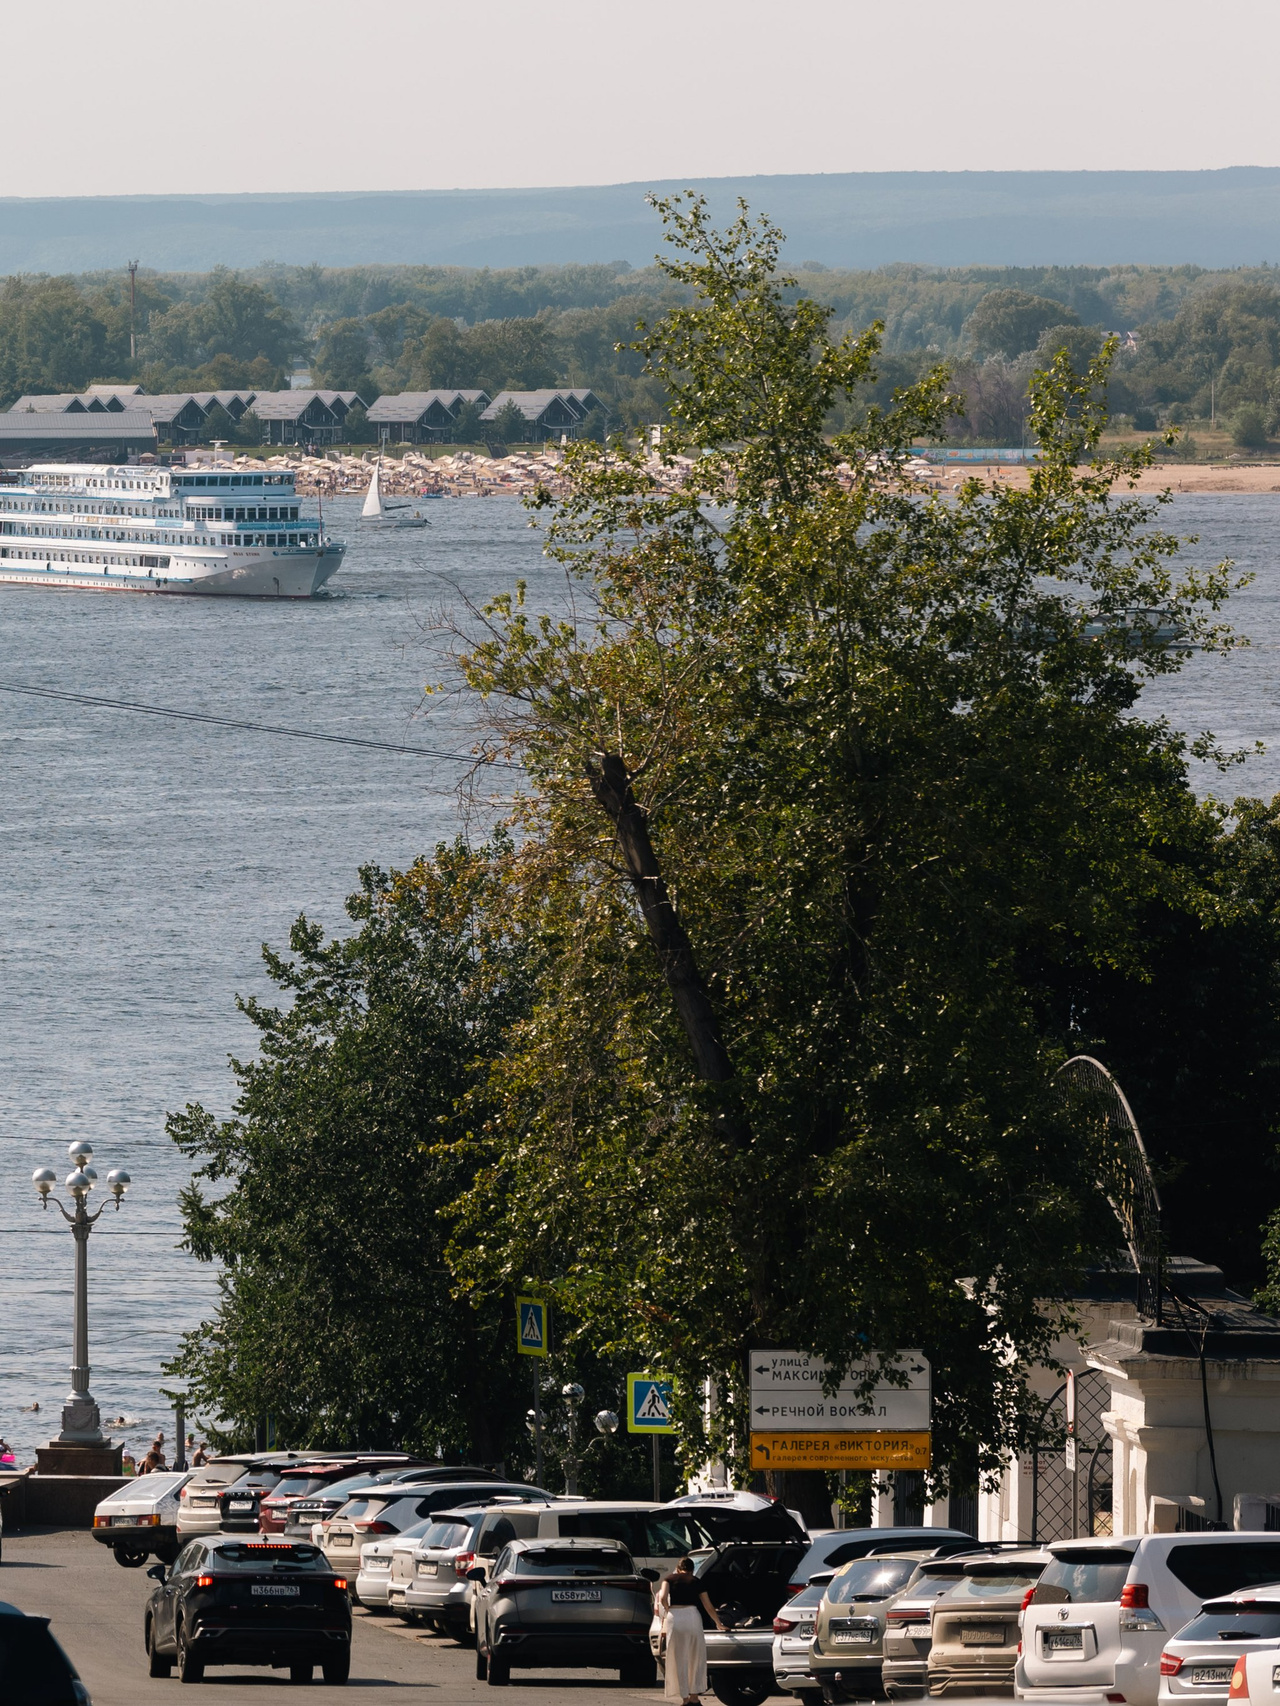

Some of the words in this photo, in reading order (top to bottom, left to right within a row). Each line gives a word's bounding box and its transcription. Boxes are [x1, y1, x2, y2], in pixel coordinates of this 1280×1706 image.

[771, 1358, 809, 1369] улица
[772, 1404, 825, 1417] РЕЧНОЙ
[772, 1440, 830, 1451] ГАЛЕРЕЯ
[834, 1440, 915, 1451] «ВИКТОРИЯ»
[772, 1455, 808, 1463] галерея
[809, 1455, 868, 1463] современного
[870, 1454, 914, 1463] искусства
[554, 1591, 586, 1600] К658УР
[908, 1627, 932, 1636] С989Р
[1195, 1669, 1226, 1681] В213НМ
